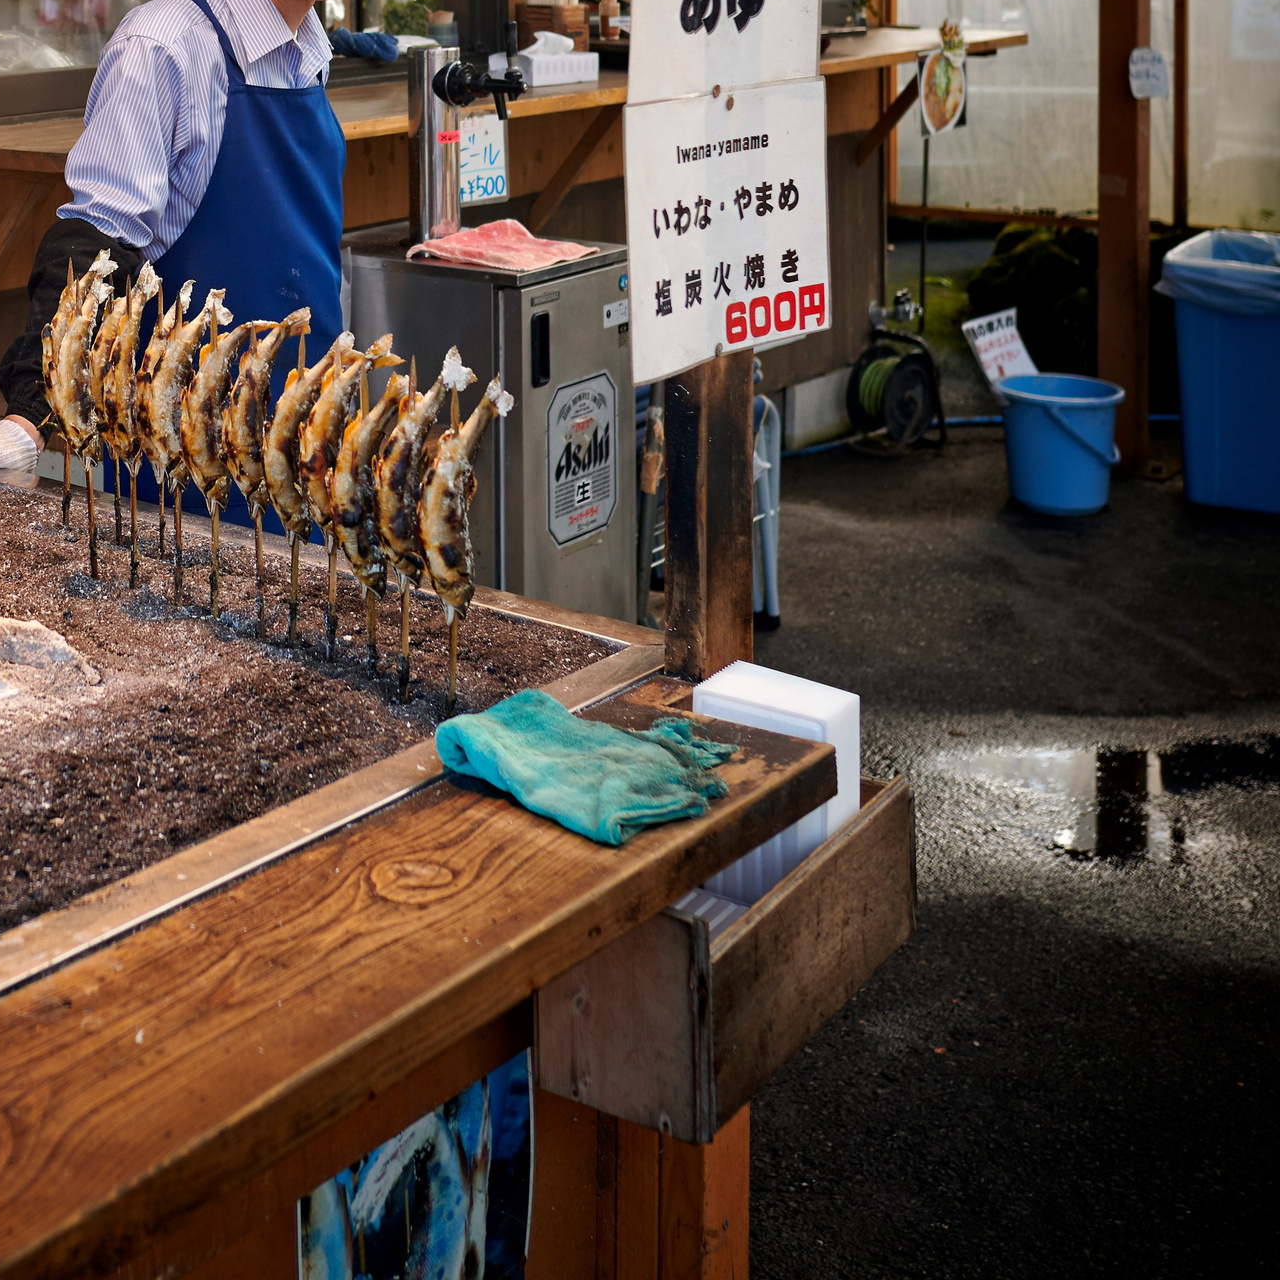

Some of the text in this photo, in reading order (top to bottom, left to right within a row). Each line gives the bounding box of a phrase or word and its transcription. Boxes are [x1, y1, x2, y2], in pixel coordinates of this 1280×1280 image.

[725, 282, 825, 345] 600円
[555, 421, 610, 483] Asahi
[576, 480, 591, 504] 生
